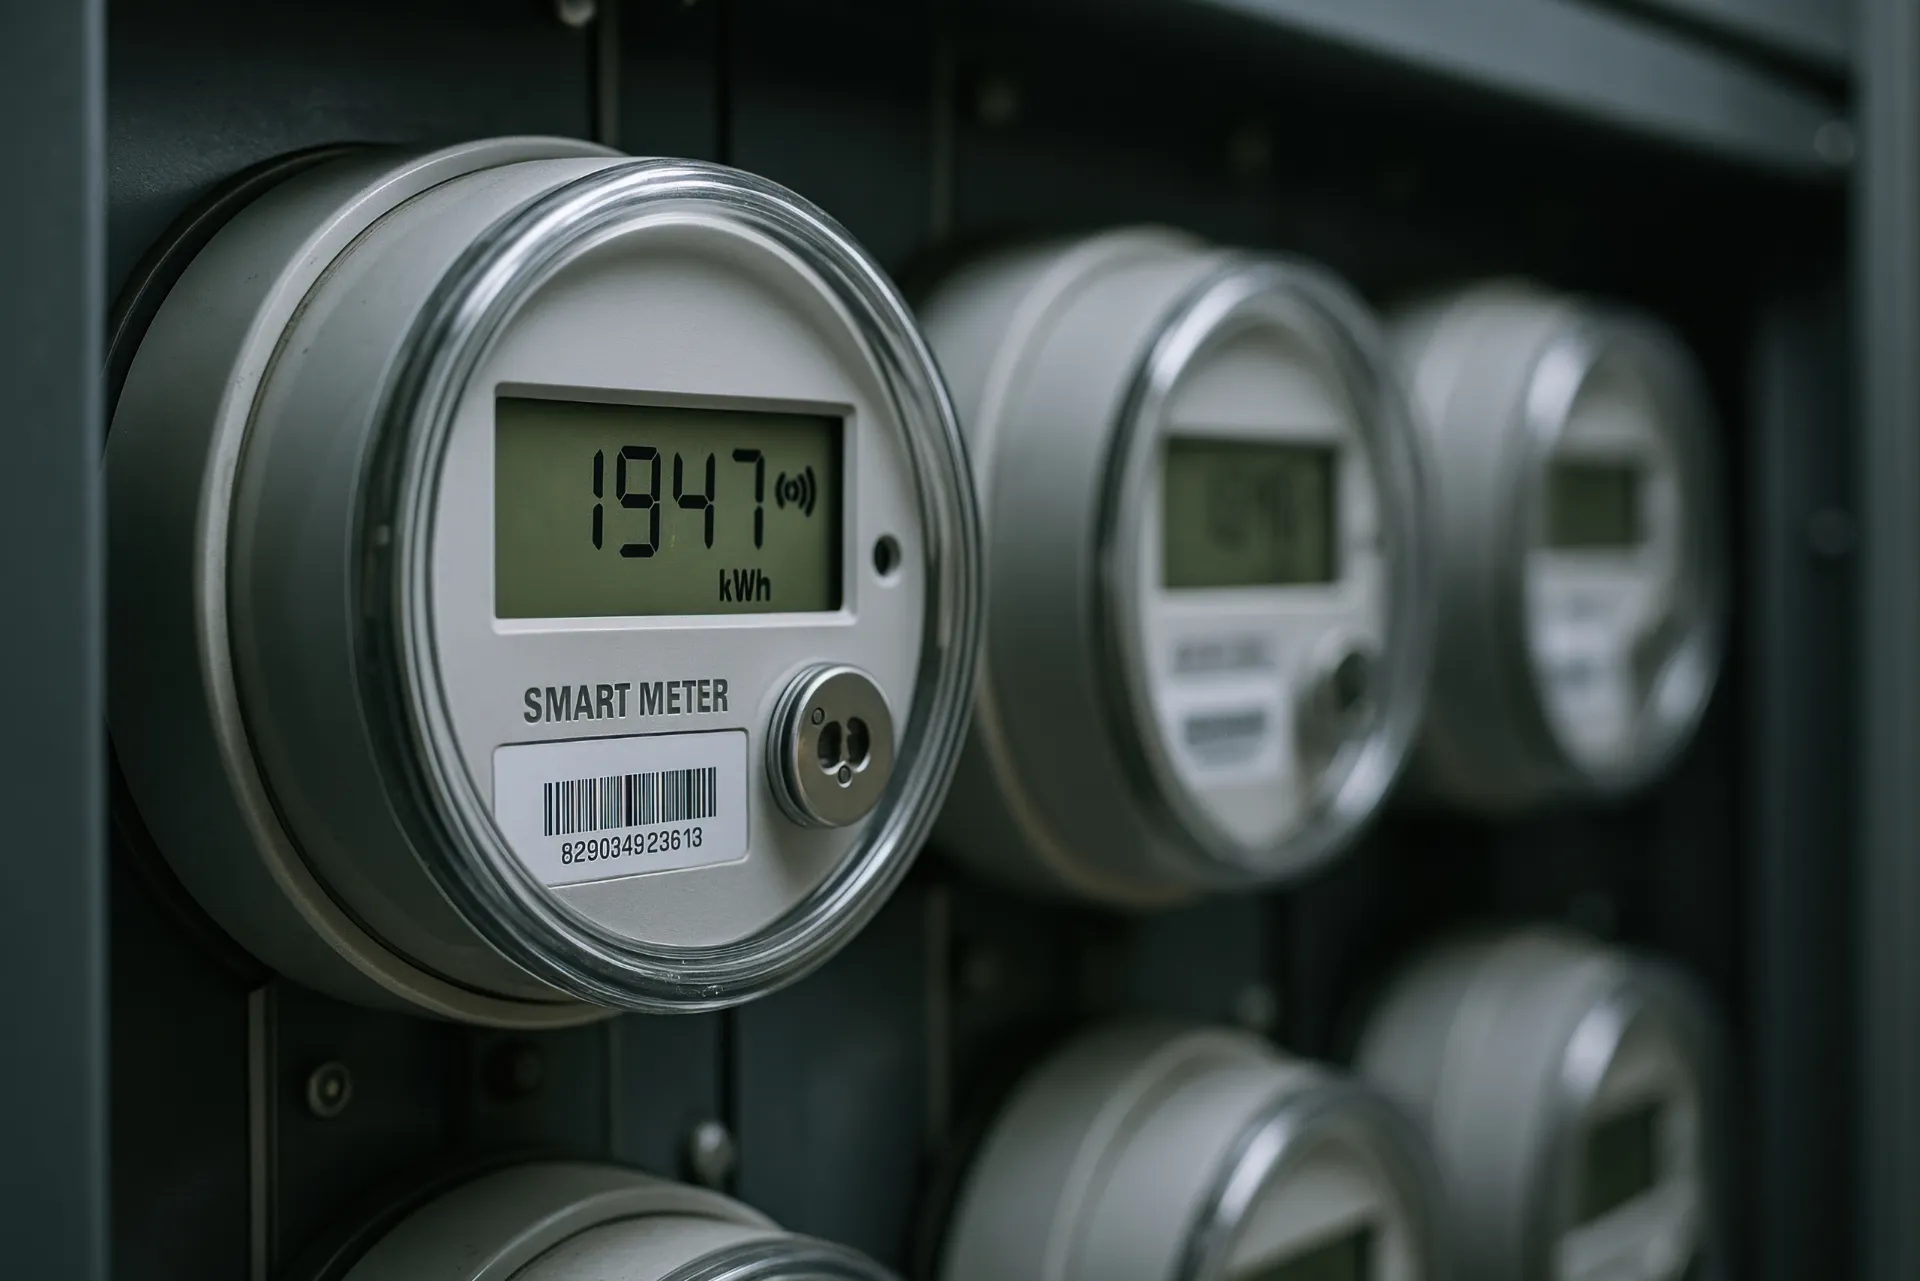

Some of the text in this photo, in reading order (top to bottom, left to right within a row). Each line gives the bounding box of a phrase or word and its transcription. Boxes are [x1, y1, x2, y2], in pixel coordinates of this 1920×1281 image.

[592, 445, 765, 558] 1947
[719, 569, 771, 602] kWh
[523, 678, 728, 724] SMART METER
[561, 827, 703, 865] 829034923613
